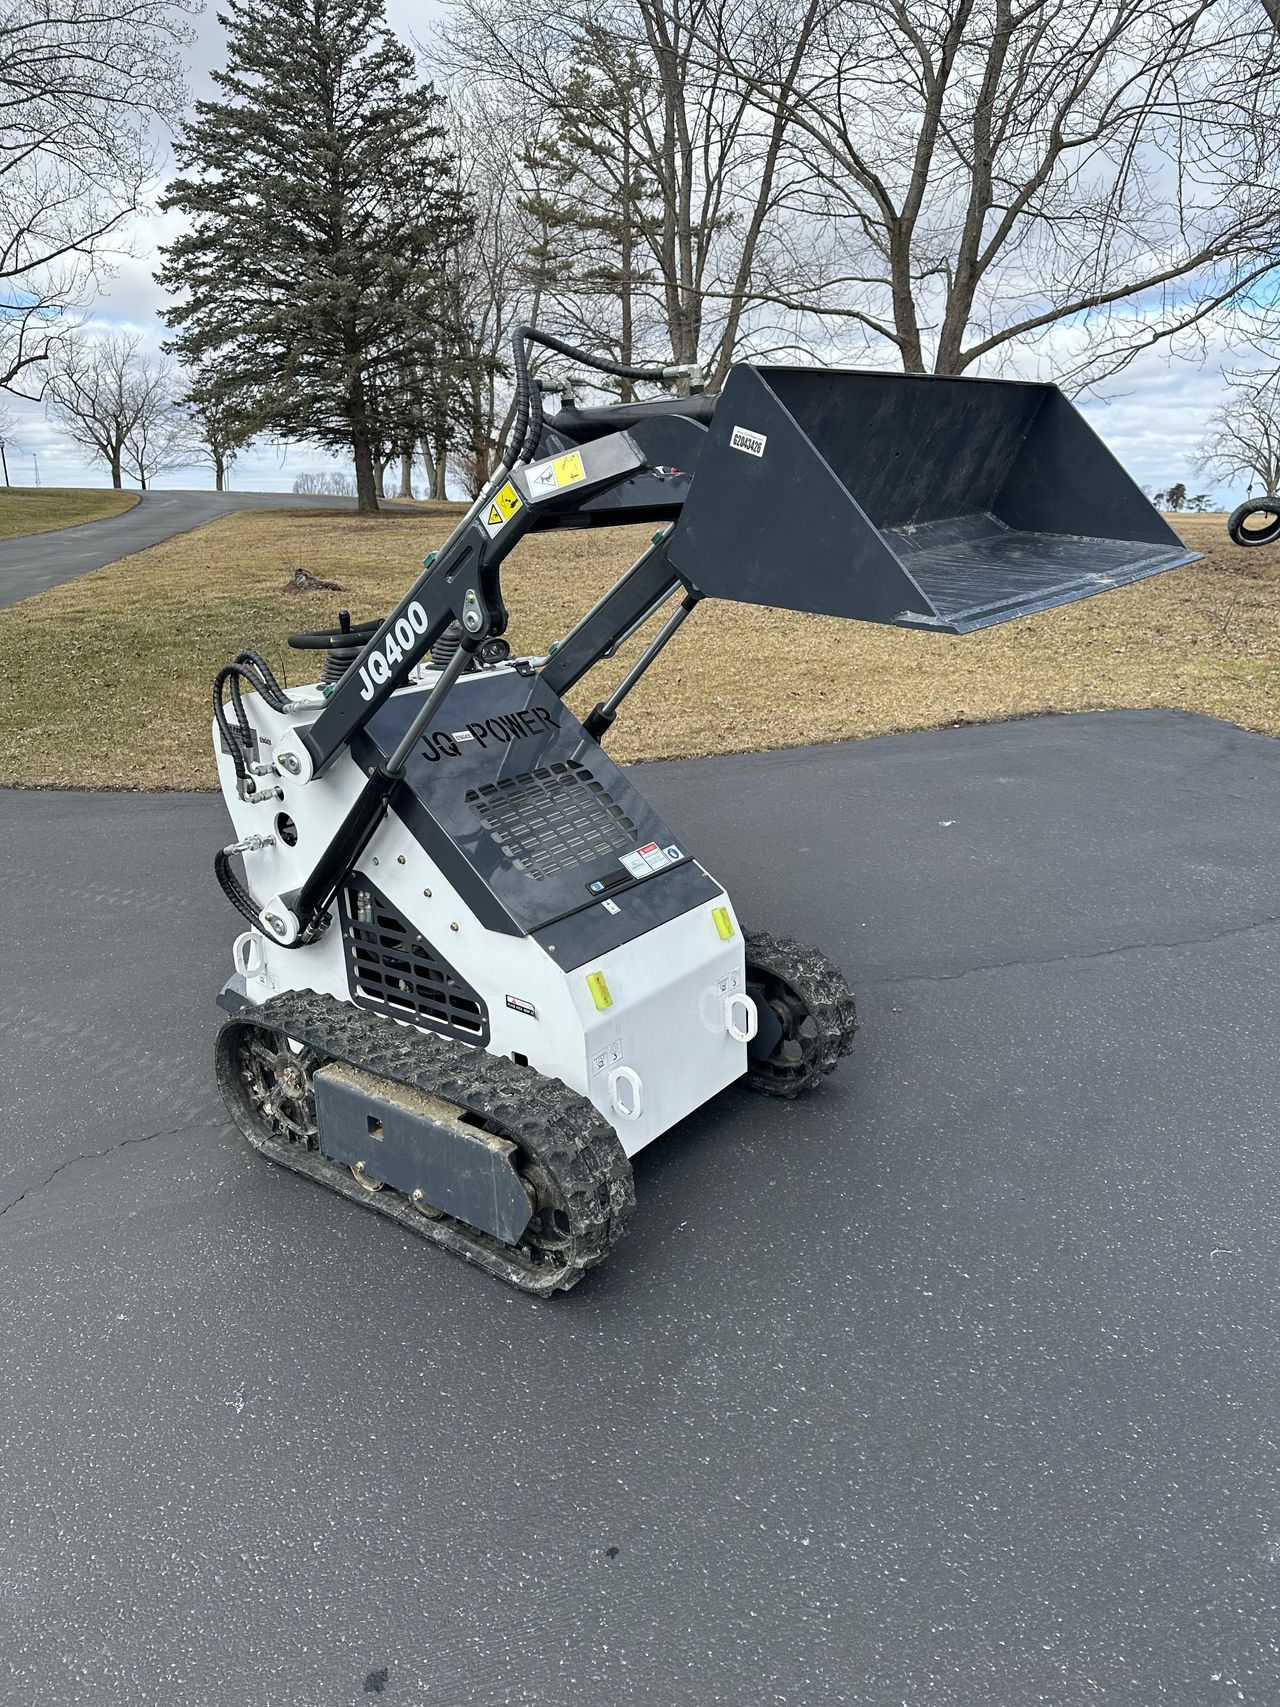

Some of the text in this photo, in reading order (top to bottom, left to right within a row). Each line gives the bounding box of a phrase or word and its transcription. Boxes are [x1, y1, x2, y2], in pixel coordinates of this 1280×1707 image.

[732, 433, 763, 454] 62043426
[359, 600, 428, 701] JQ400
[421, 707, 562, 763] JQ POWER
